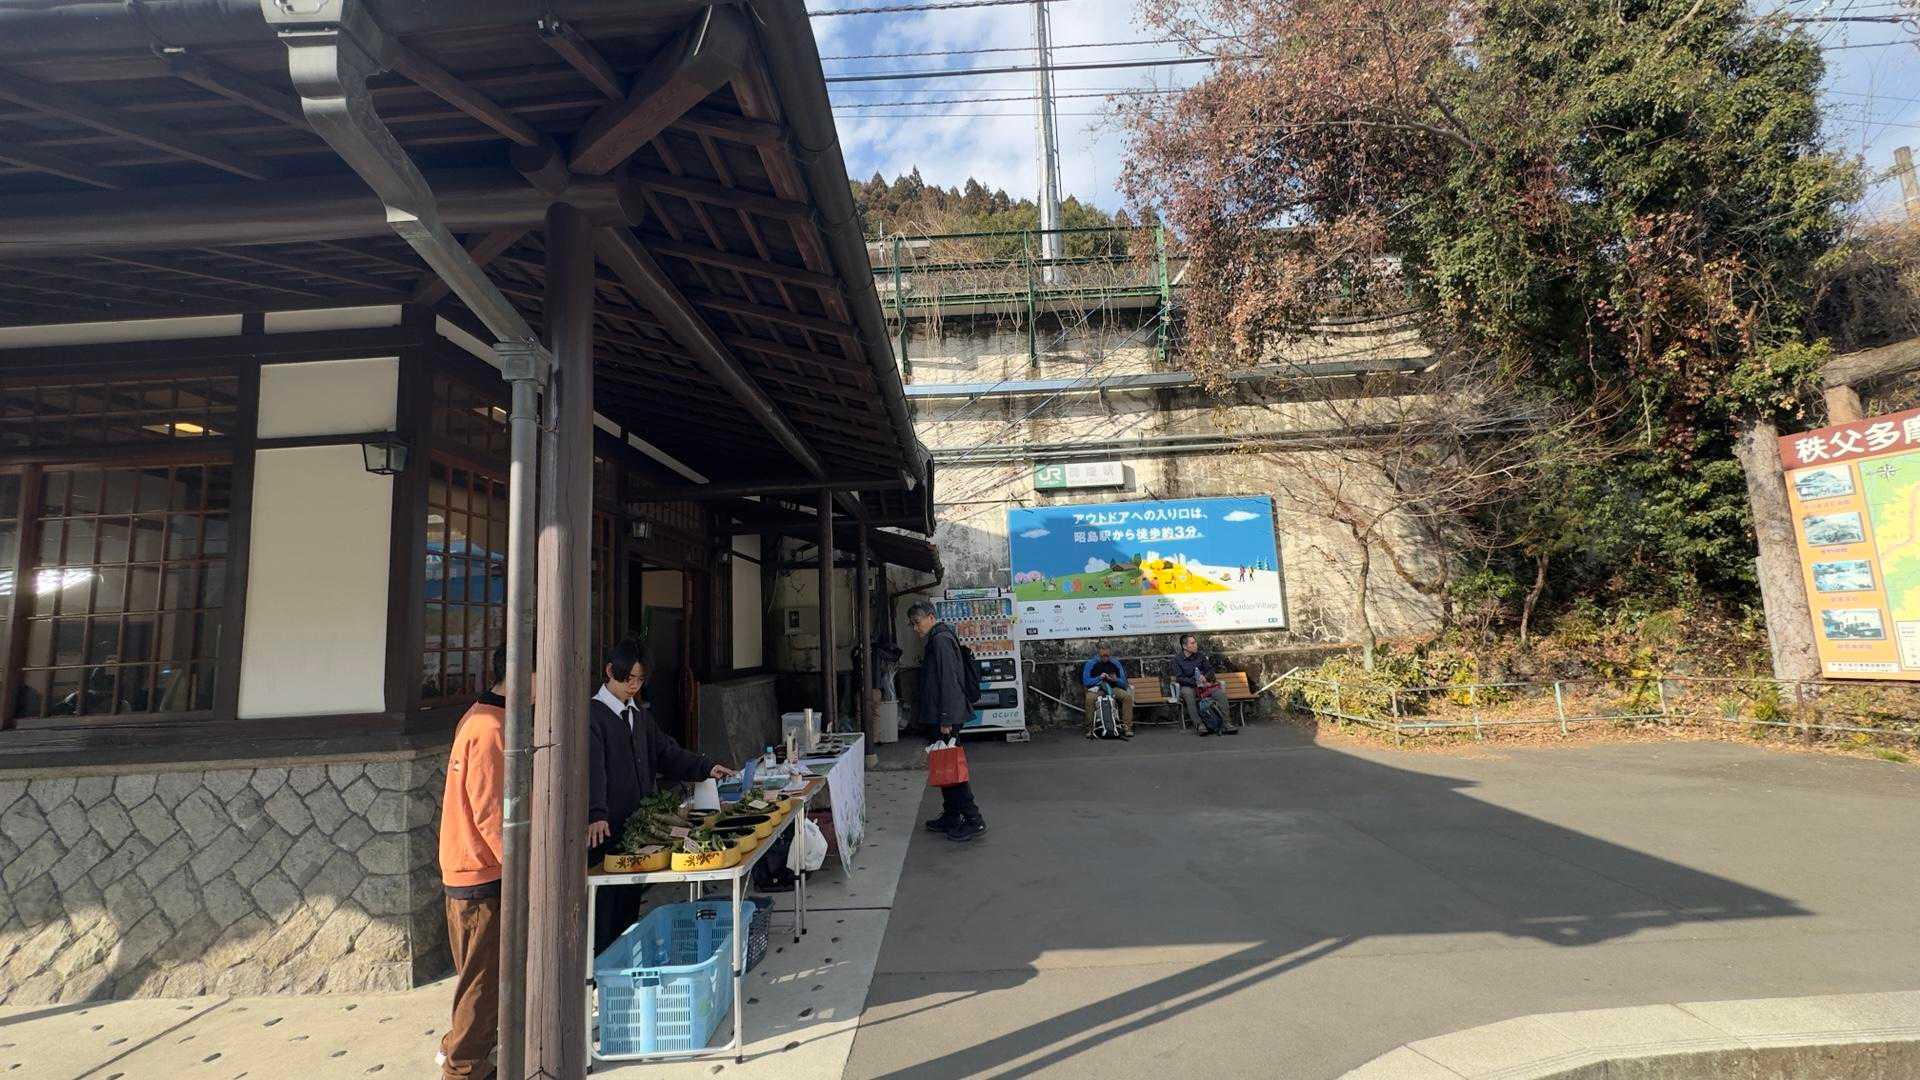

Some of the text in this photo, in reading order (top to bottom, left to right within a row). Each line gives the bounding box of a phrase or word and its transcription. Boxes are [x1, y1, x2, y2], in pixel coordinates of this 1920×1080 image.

[1038, 466, 1061, 482] JR
[1073, 508, 1208, 525] アウトドアへの入り口は、
[1073, 525, 1203, 543] 昭島駅から徒歩約3分。
